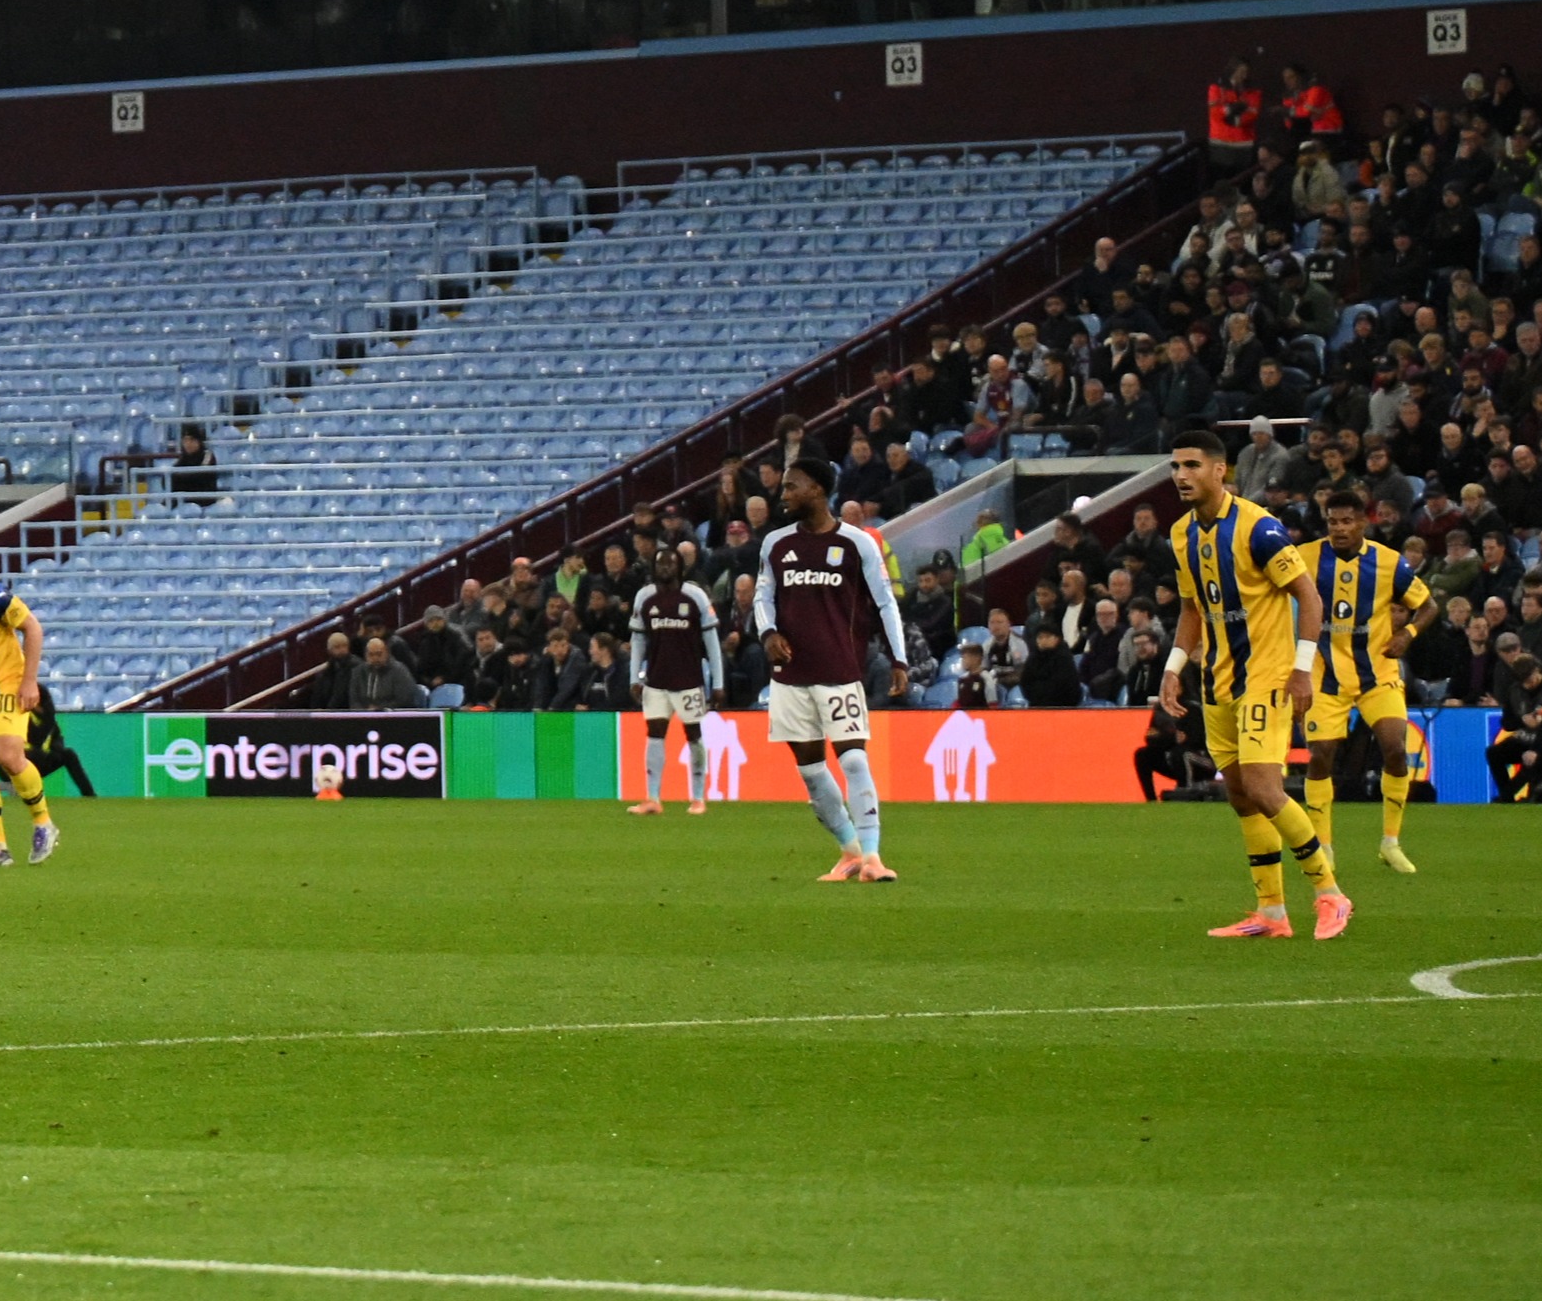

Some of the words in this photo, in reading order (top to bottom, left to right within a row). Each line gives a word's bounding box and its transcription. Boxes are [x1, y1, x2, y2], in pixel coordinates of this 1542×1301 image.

[1433, 23, 1461, 42] Q3
[891, 55, 917, 74] Q3
[117, 103, 139, 121] Q2
[783, 570, 842, 587] Betano
[651, 617, 690, 630] Betano
[828, 693, 861, 722] 26
[1241, 704, 1266, 734] 19
[166, 730, 439, 793] enterprise
